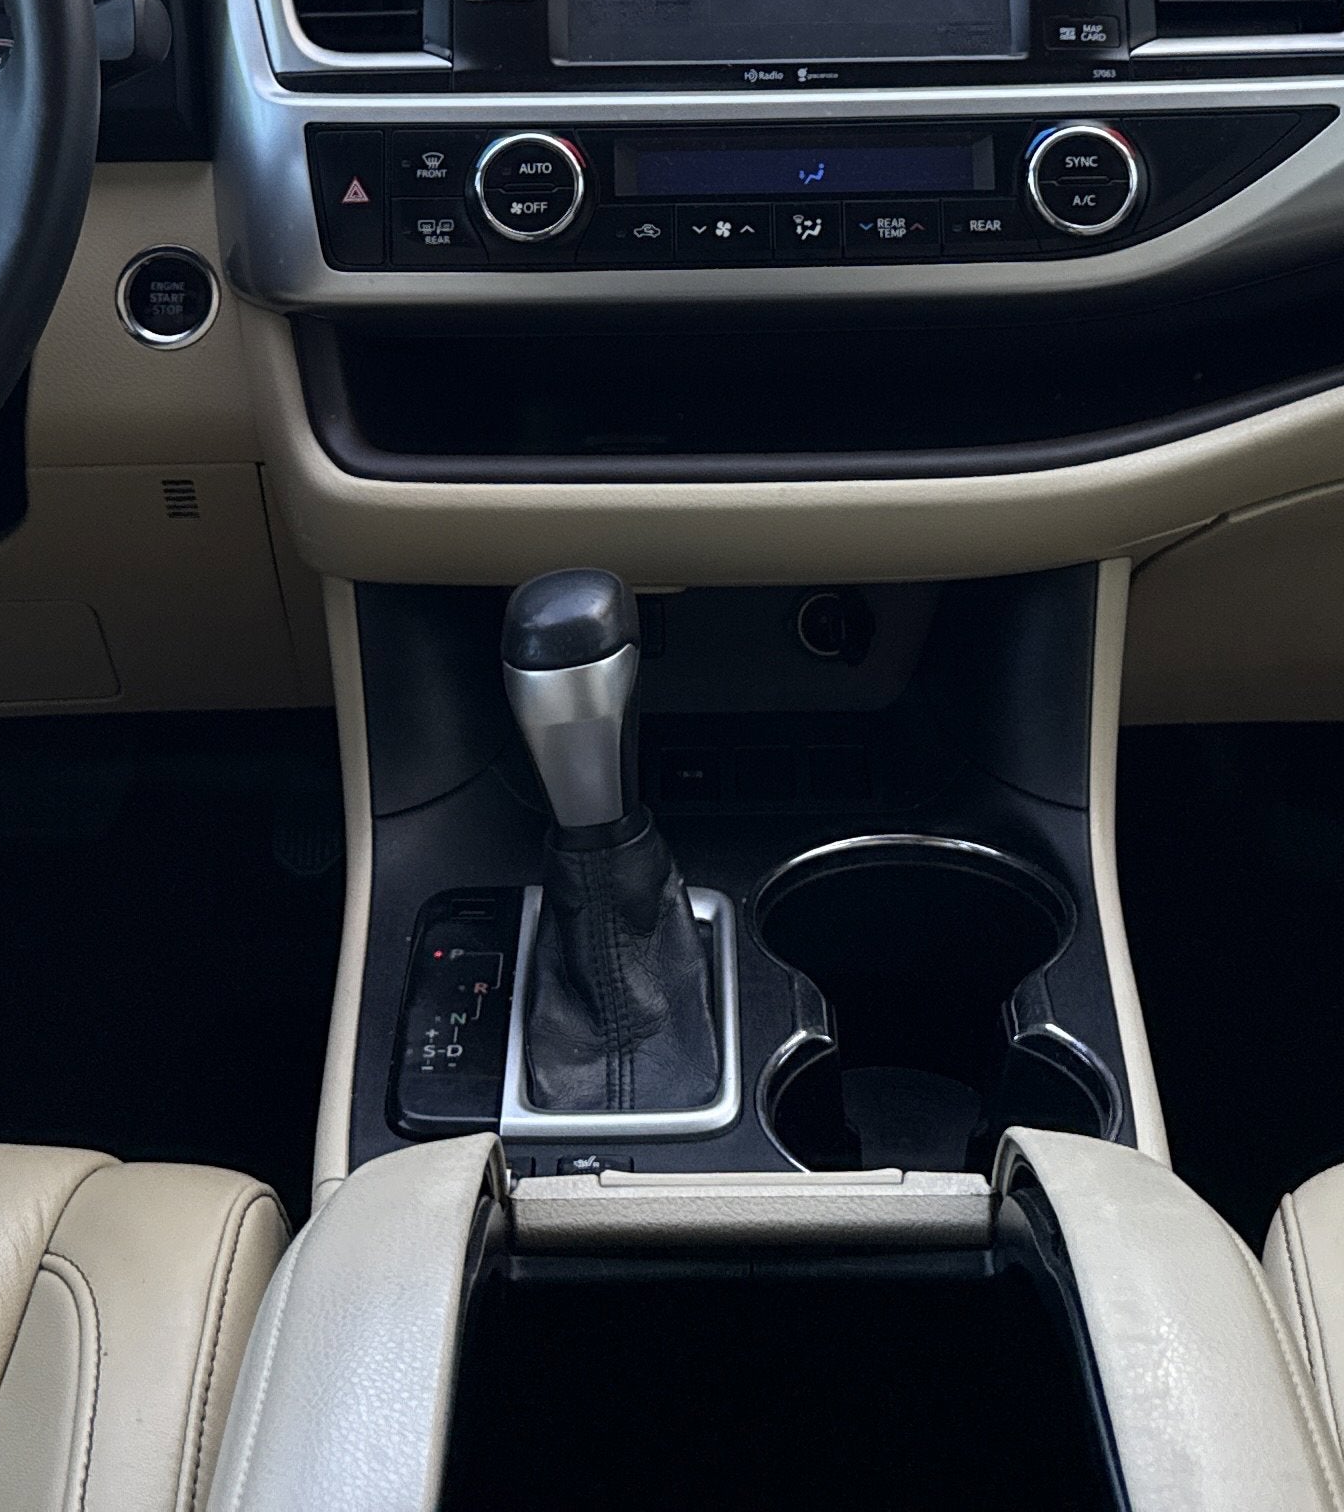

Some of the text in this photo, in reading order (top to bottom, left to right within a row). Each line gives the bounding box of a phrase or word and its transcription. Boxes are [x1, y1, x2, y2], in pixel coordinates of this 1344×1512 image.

[1082, 24, 1103, 33] MAP
[1081, 33, 1106, 42] CARD
[759, 71, 784, 80] Radio
[1092, 69, 1116, 78] 57063
[1065, 156, 1098, 168] SYNC
[416, 169, 447, 178] FRONT
[519, 163, 552, 174] AUTO
[1072, 194, 1096, 206] A/C
[524, 202, 548, 214] OFF
[877, 218, 906, 228] REAR
[970, 220, 1001, 231] REAR
[878, 229, 906, 238] TEMP
[425, 235, 451, 244] REAR
[151, 281, 185, 291] ENGINE
[150, 293, 185, 303] START
[152, 305, 183, 316] STOP
[450, 949, 464, 959] P
[474, 982, 488, 994] R
[450, 1013, 467, 1025] N
[423, 1045, 436, 1058] S
[446, 1045, 463, 1058] D
